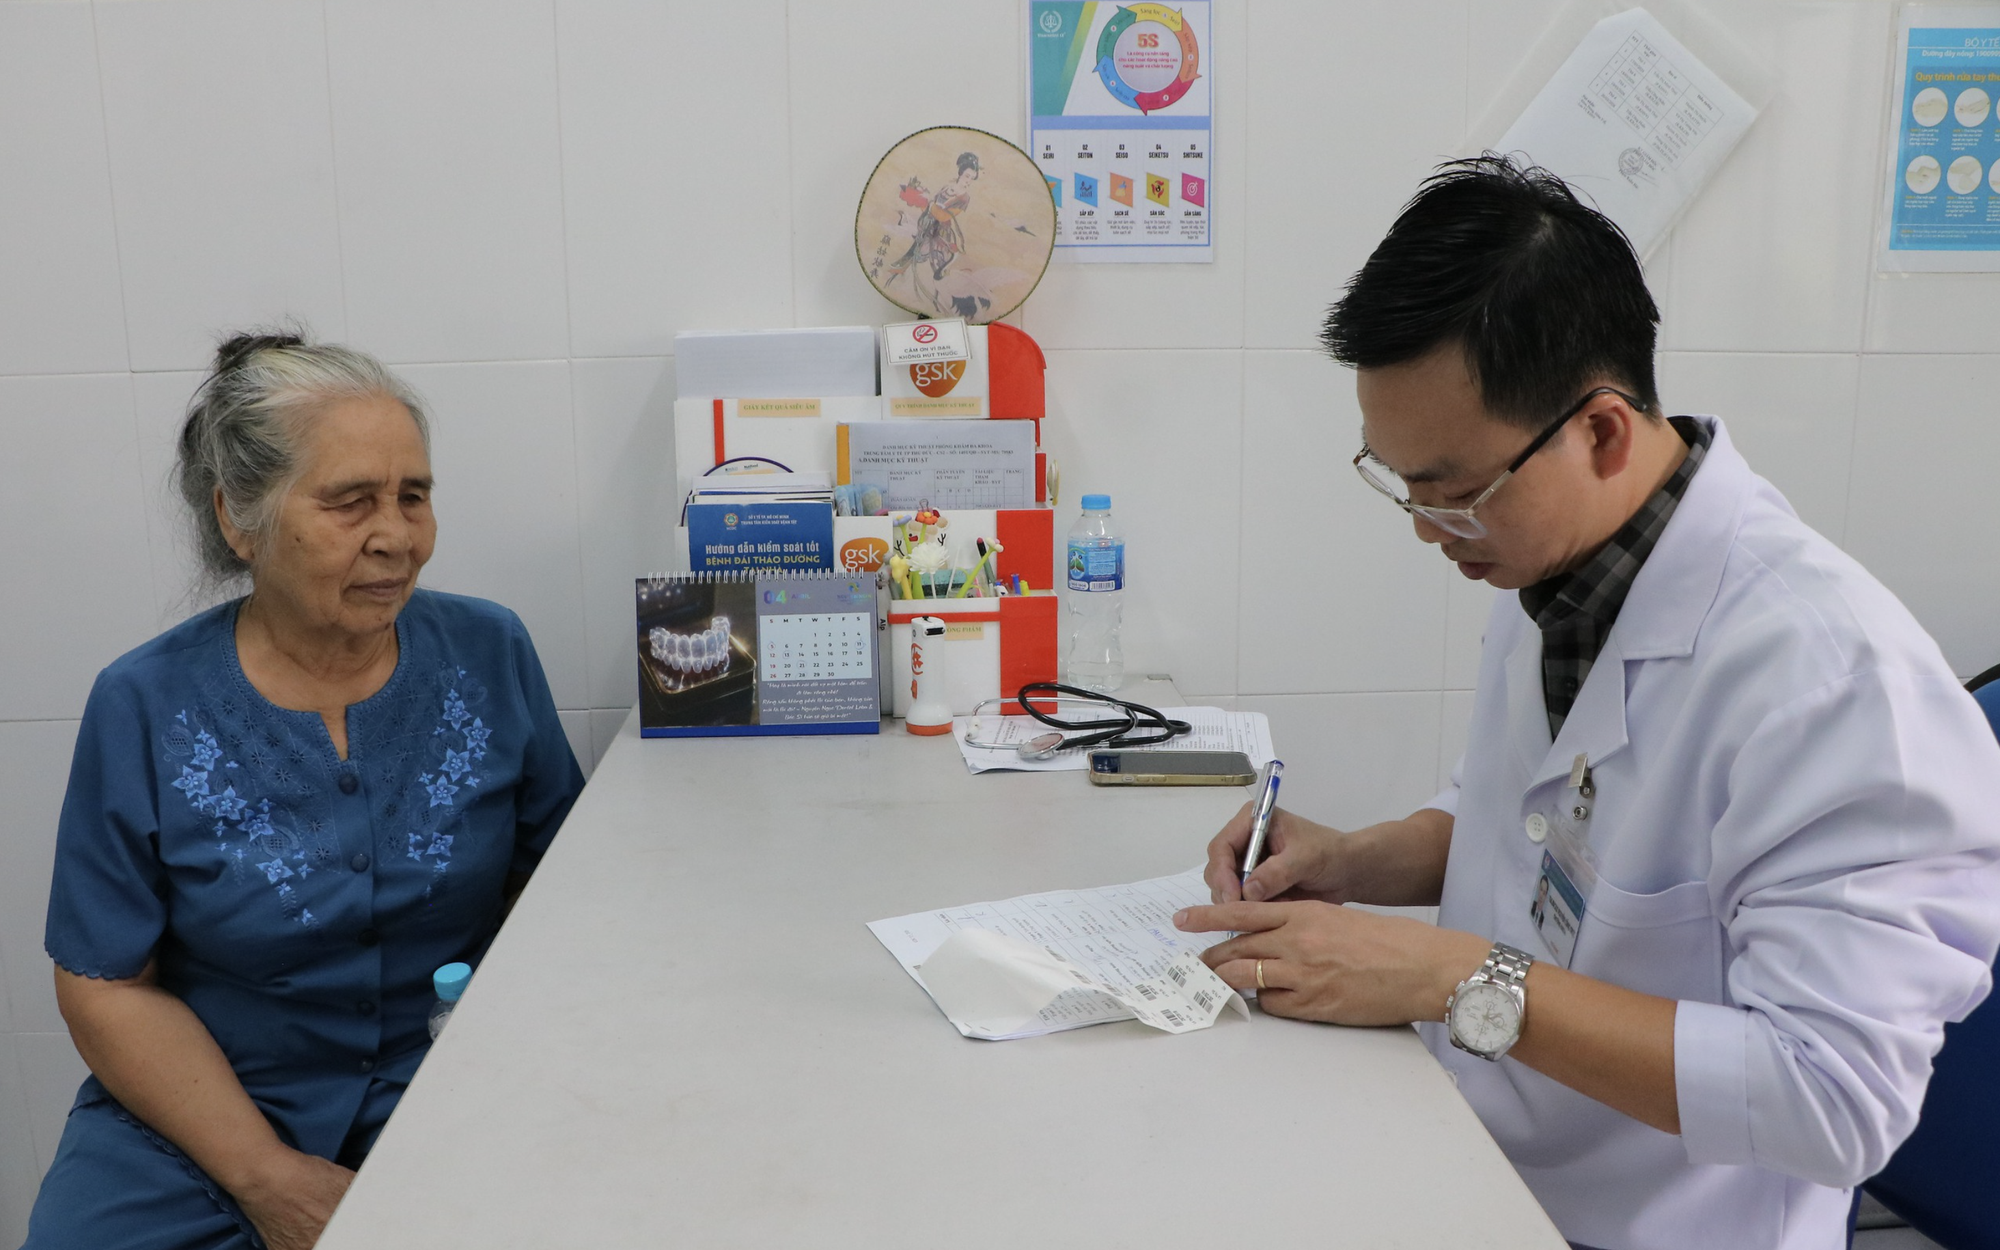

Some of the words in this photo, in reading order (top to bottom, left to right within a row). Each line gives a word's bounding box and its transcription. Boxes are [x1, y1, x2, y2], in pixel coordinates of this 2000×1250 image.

[1137, 33, 1160, 48] 5S
[1981, 38, 1987, 46] Y
[1915, 72, 1933, 82] Quy
[1973, 74, 1986, 82] tay
[916, 360, 958, 387] gsk
[705, 544, 734, 555] Hướng
[738, 541, 754, 554] dẫn
[783, 542, 804, 552] soát
[806, 542, 819, 552] tốt
[706, 557, 732, 566] BỆNH
[734, 554, 750, 564] ĐÁI
[753, 553, 781, 564] THÁO
[784, 552, 820, 563] ĐƯỜNG
[844, 544, 882, 570] gsk
[763, 590, 787, 604] 04
